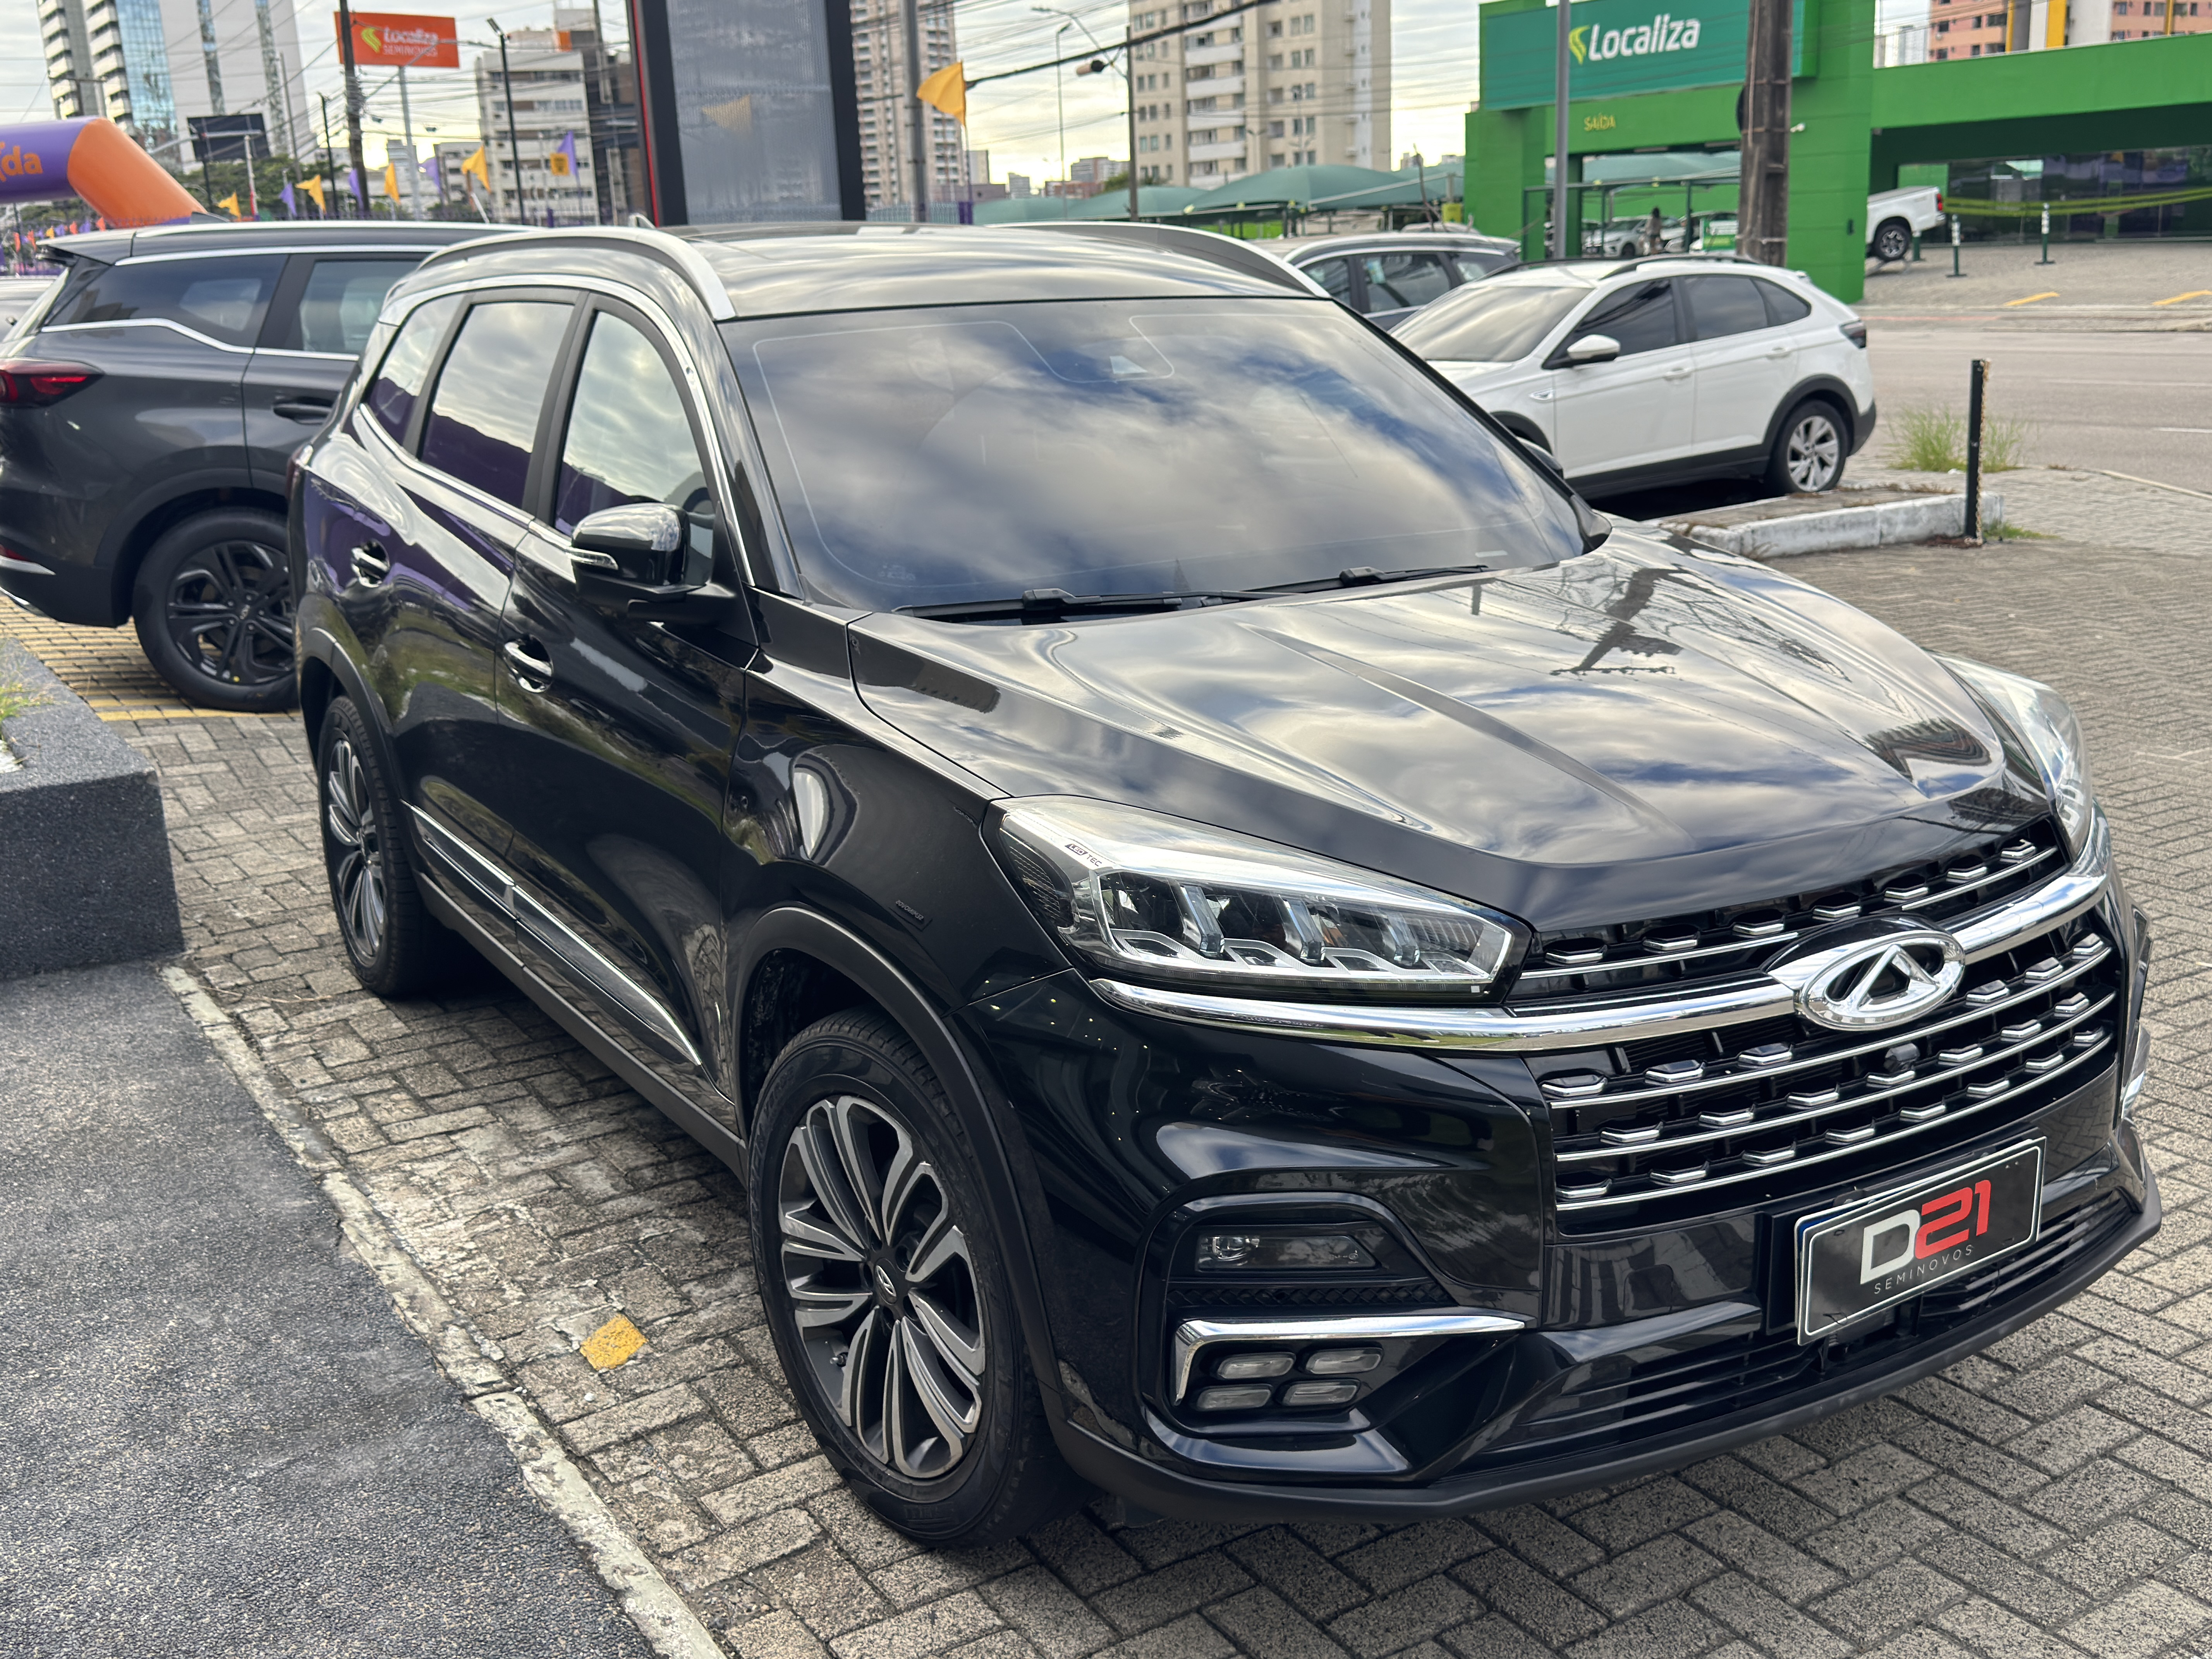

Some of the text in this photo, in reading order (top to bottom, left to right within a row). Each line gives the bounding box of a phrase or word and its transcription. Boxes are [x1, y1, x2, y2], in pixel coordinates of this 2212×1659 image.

[1589, 13, 1701, 61] Localiza
[1069, 844, 1102, 867] LED TEC
[1860, 1180, 1991, 1285] D21
[1874, 1244, 1974, 1294] SEMINOVOS
